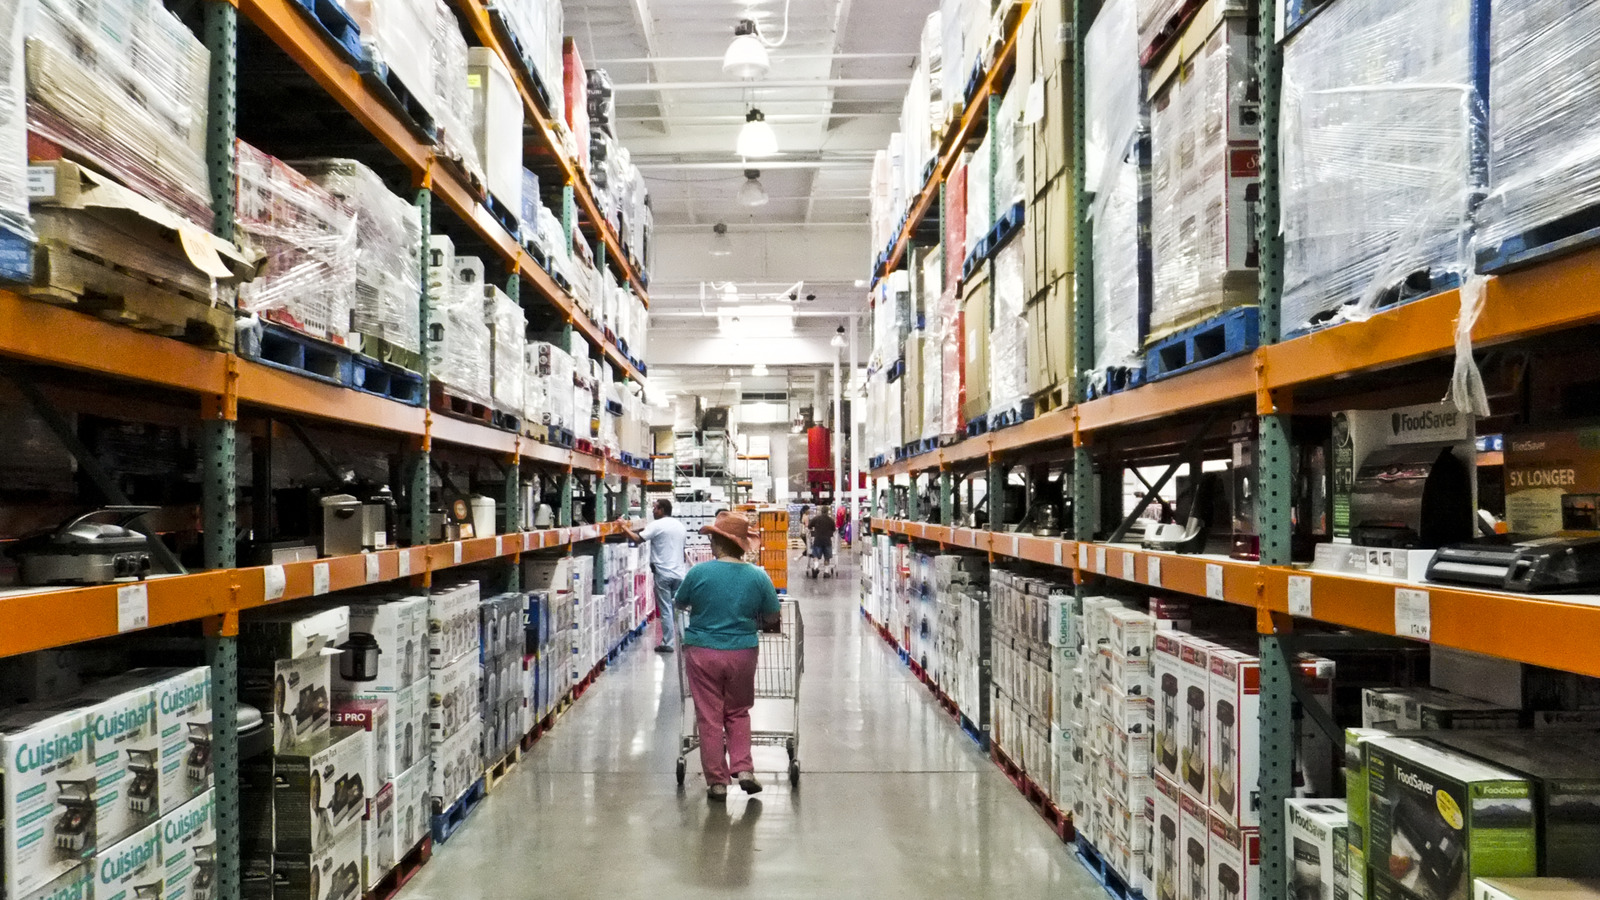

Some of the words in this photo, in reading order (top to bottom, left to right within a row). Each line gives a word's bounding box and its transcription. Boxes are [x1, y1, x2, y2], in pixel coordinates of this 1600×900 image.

[1401, 410, 1458, 431] FoodSaver
[1527, 469, 1576, 486] LONGER
[1059, 602, 1068, 645] Cuisinart
[161, 680, 211, 715] Cuisinart
[95, 700, 156, 741] Cuisinart
[344, 713, 366, 722] PRO
[15, 723, 95, 773] Cuisinart
[1397, 767, 1434, 796] FoodSaver
[164, 799, 215, 844] Cuisinart
[1295, 810, 1327, 842] FoodSaver
[100, 833, 163, 885] Cuisinart
